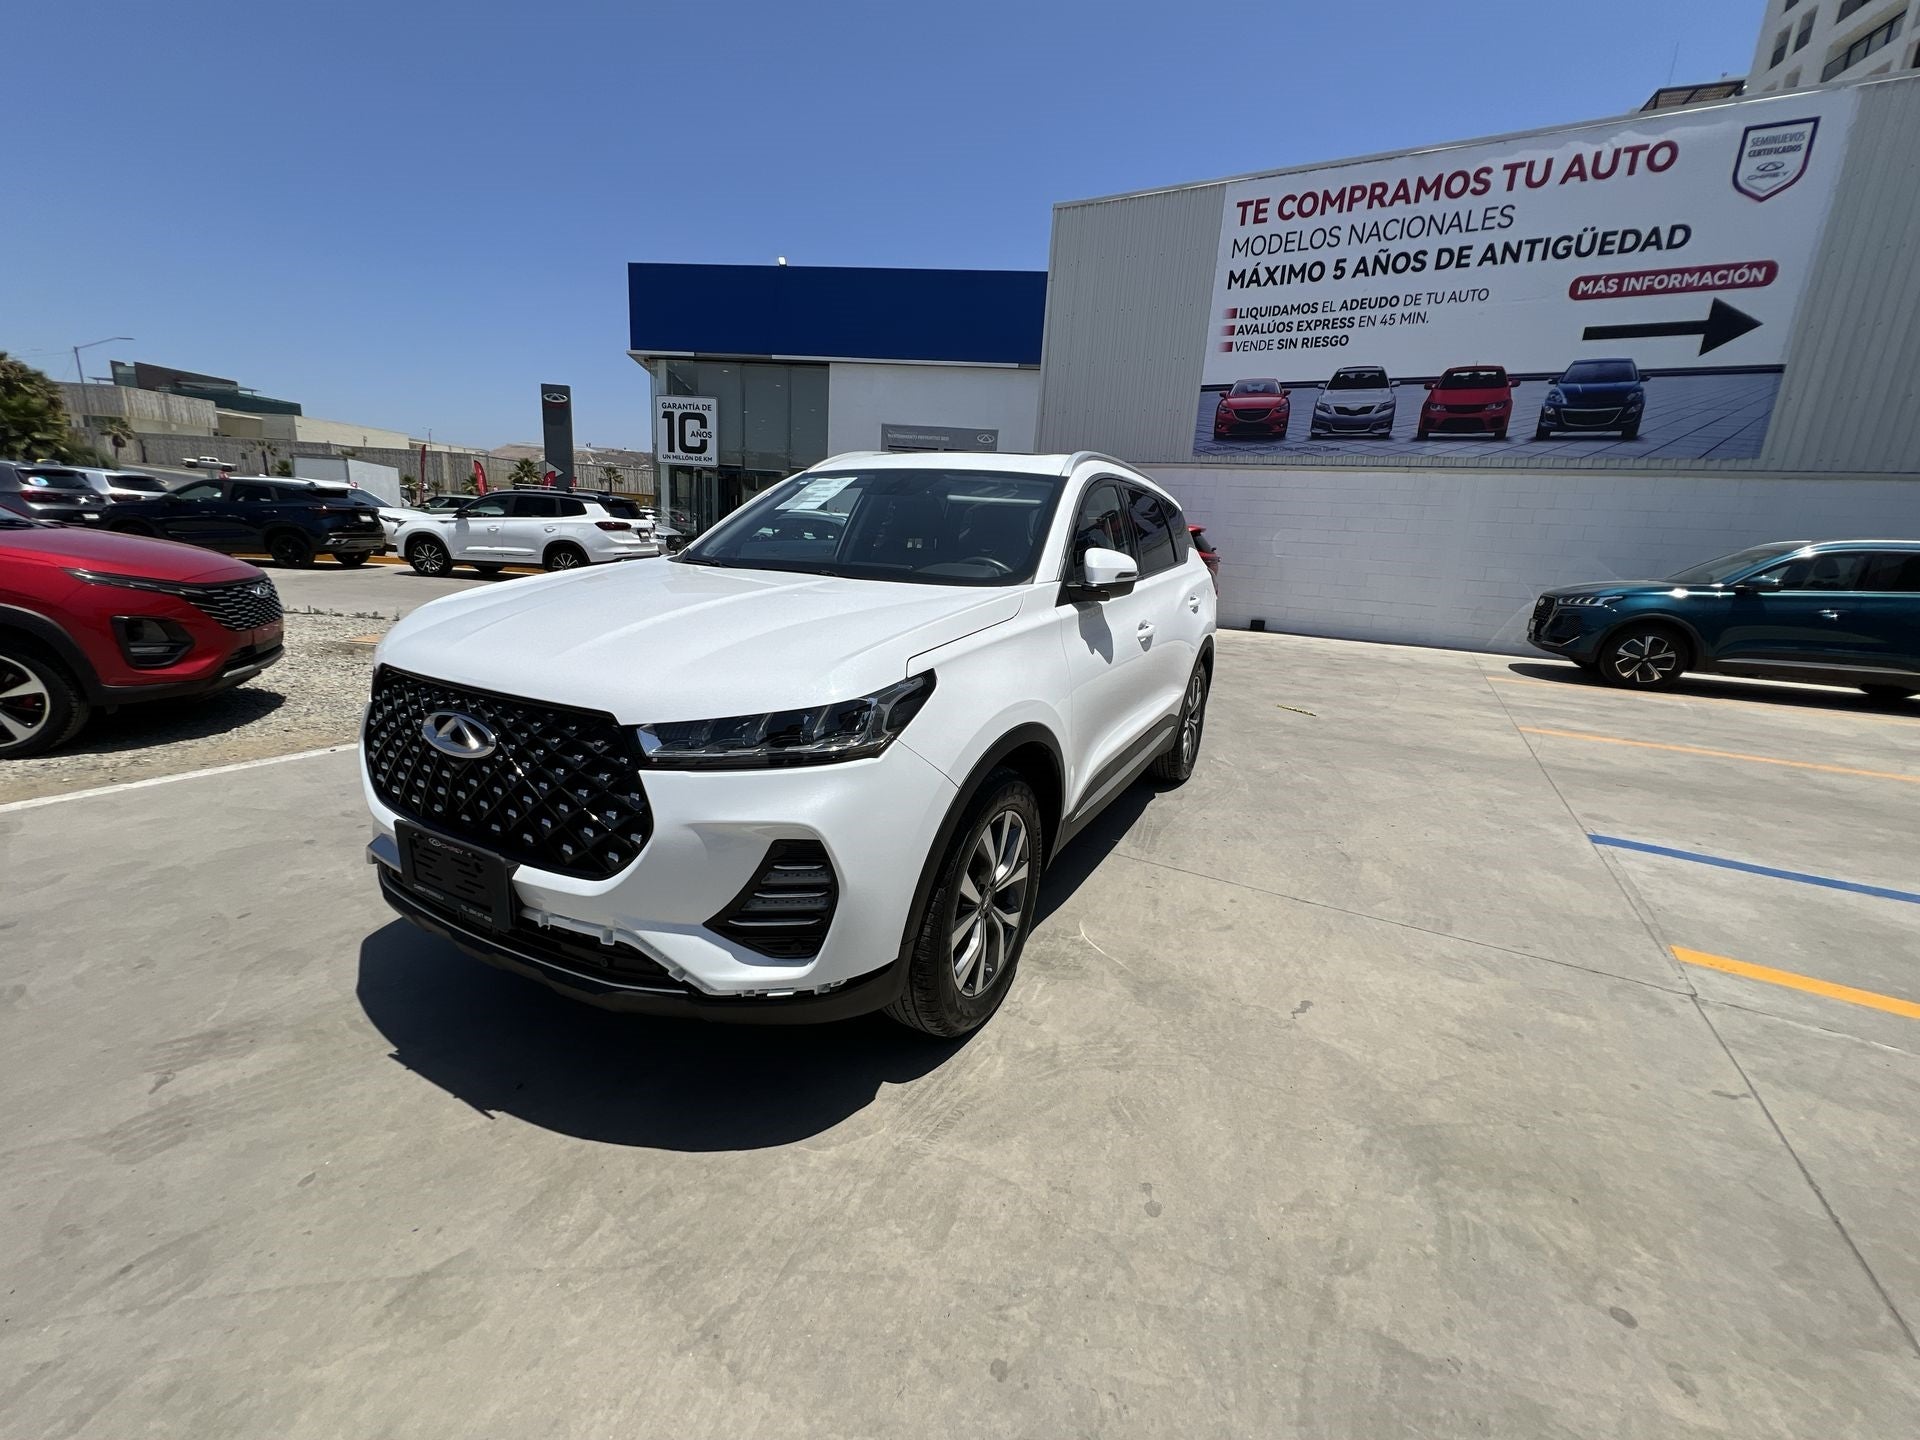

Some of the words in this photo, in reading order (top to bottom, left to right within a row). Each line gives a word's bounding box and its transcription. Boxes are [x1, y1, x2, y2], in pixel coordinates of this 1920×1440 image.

[1748, 143, 1803, 158] CERTIFICADOS
[1750, 131, 1806, 147] SEMINUEVOS
[1237, 198, 1270, 227] TE
[1277, 166, 1493, 221] COMPRAMOS
[1503, 157, 1554, 192] TU
[1559, 140, 1679, 185] AUTO
[1231, 226, 1341, 259] MODELOS
[1348, 204, 1515, 246] NACIONALES
[1227, 262, 1325, 290] MÁXIMO
[1333, 258, 1347, 280] 5
[1351, 248, 1427, 278] AÑOS
[1435, 245, 1473, 270] DE
[1477, 224, 1692, 266] ANTIGÜEDAD
[1577, 276, 1618, 296] MÁS
[1623, 264, 1767, 292] INFORMACIÓN
[1238, 302, 1319, 319] LIQUIDAMOS
[1321, 301, 1337, 313] EL
[1339, 295, 1399, 312] ADEUDO
[1403, 294, 1422, 307] DE
[1426, 292, 1445, 305] TU
[1447, 288, 1490, 303] AUTO
[1236, 319, 1293, 336] AVALÚOS
[1296, 317, 1355, 332] EXPRESS
[1358, 315, 1377, 328] EN
[1380, 313, 1396, 326] 45
[1399, 311, 1430, 325] MIN.
[1235, 339, 1274, 352] VENDE
[1277, 337, 1298, 350] SIN
[1301, 335, 1349, 349] RIESGO
[661, 402, 700, 411] GARANTÍA
[662, 411, 707, 454] 10
[690, 429, 712, 439] AÑOS
